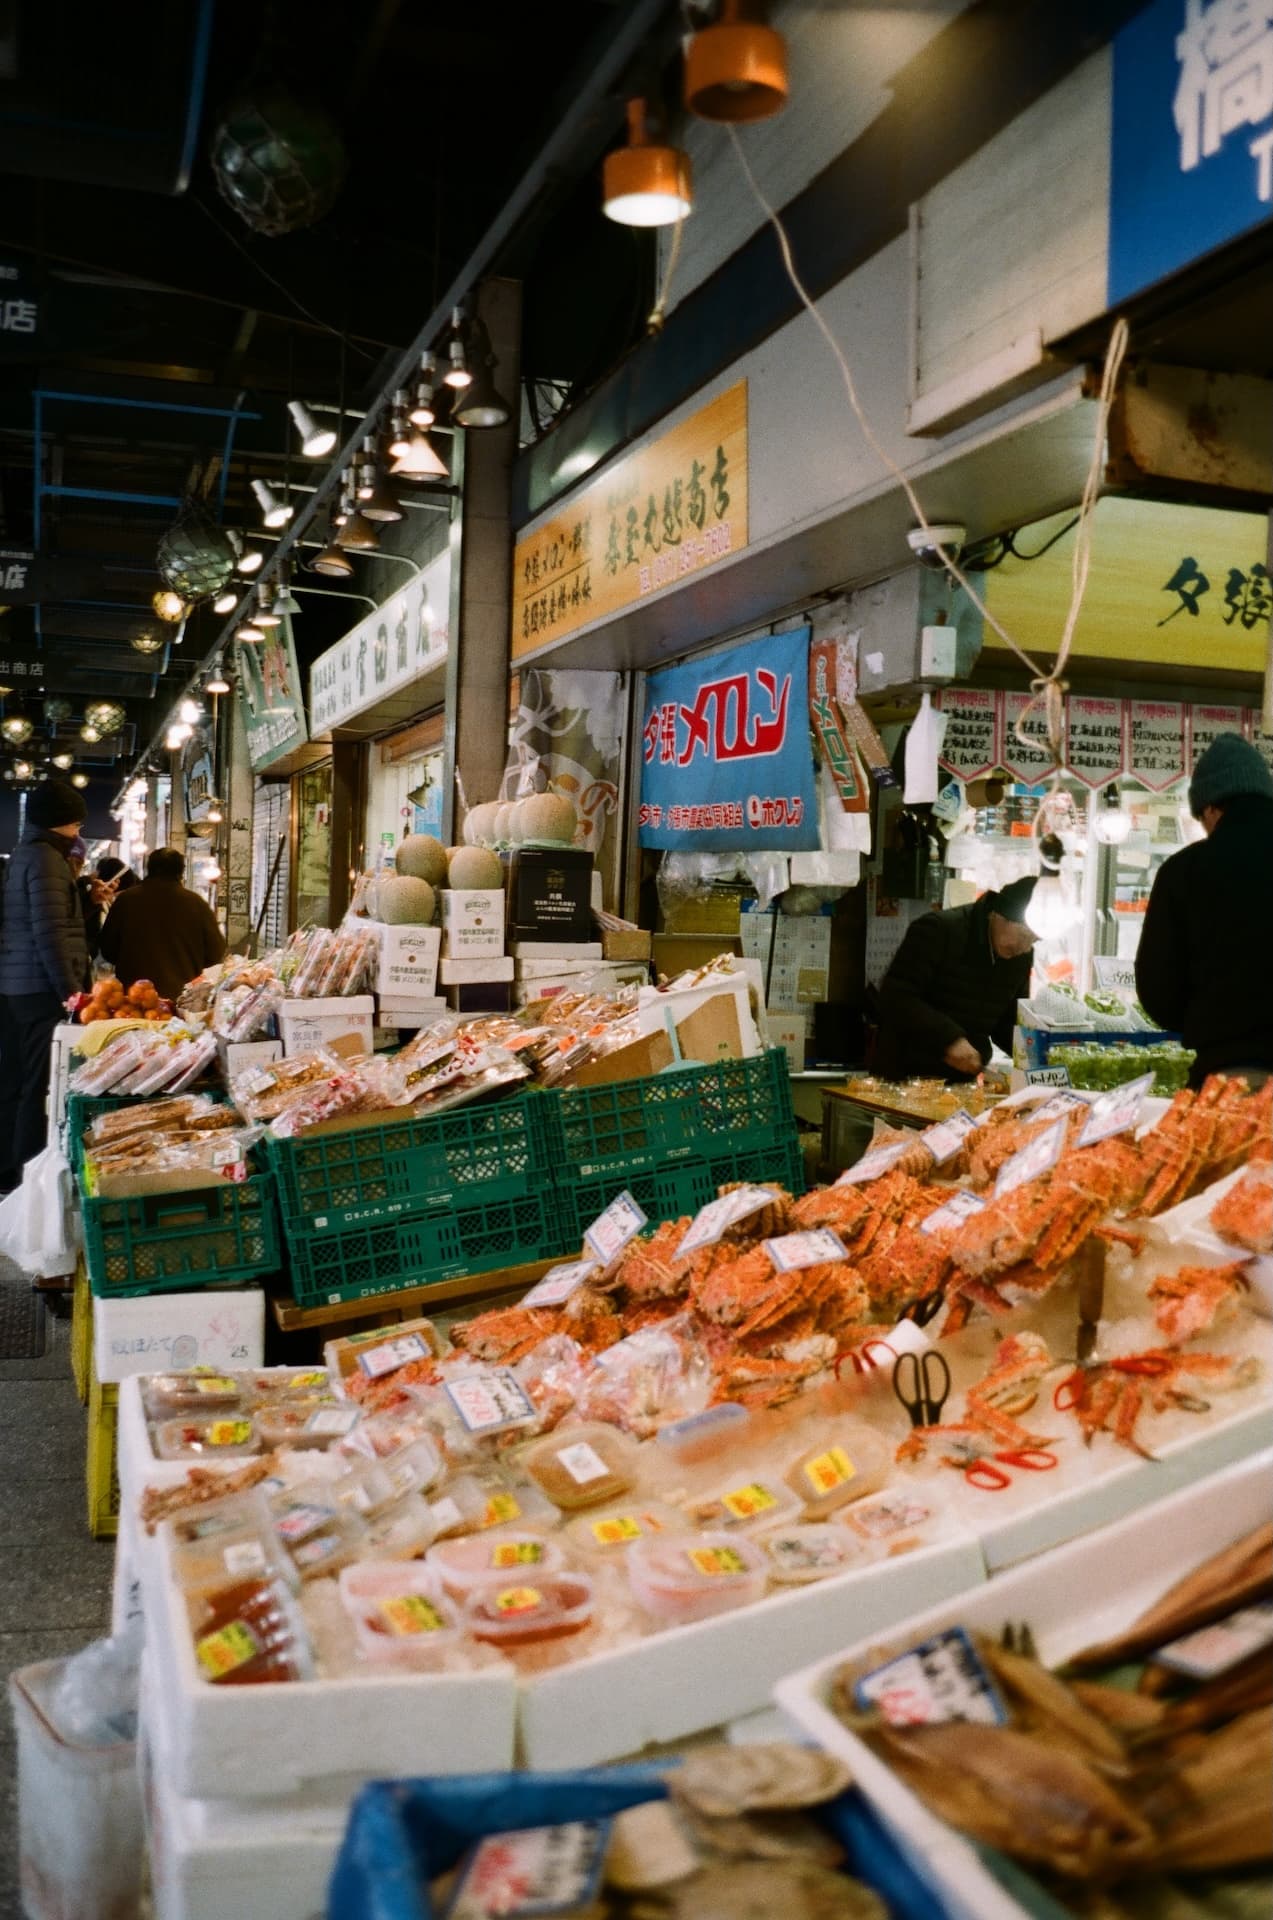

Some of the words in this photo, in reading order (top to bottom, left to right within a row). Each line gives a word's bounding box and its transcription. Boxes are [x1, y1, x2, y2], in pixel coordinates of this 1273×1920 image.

[644, 667, 792, 768] 夕張メロン
